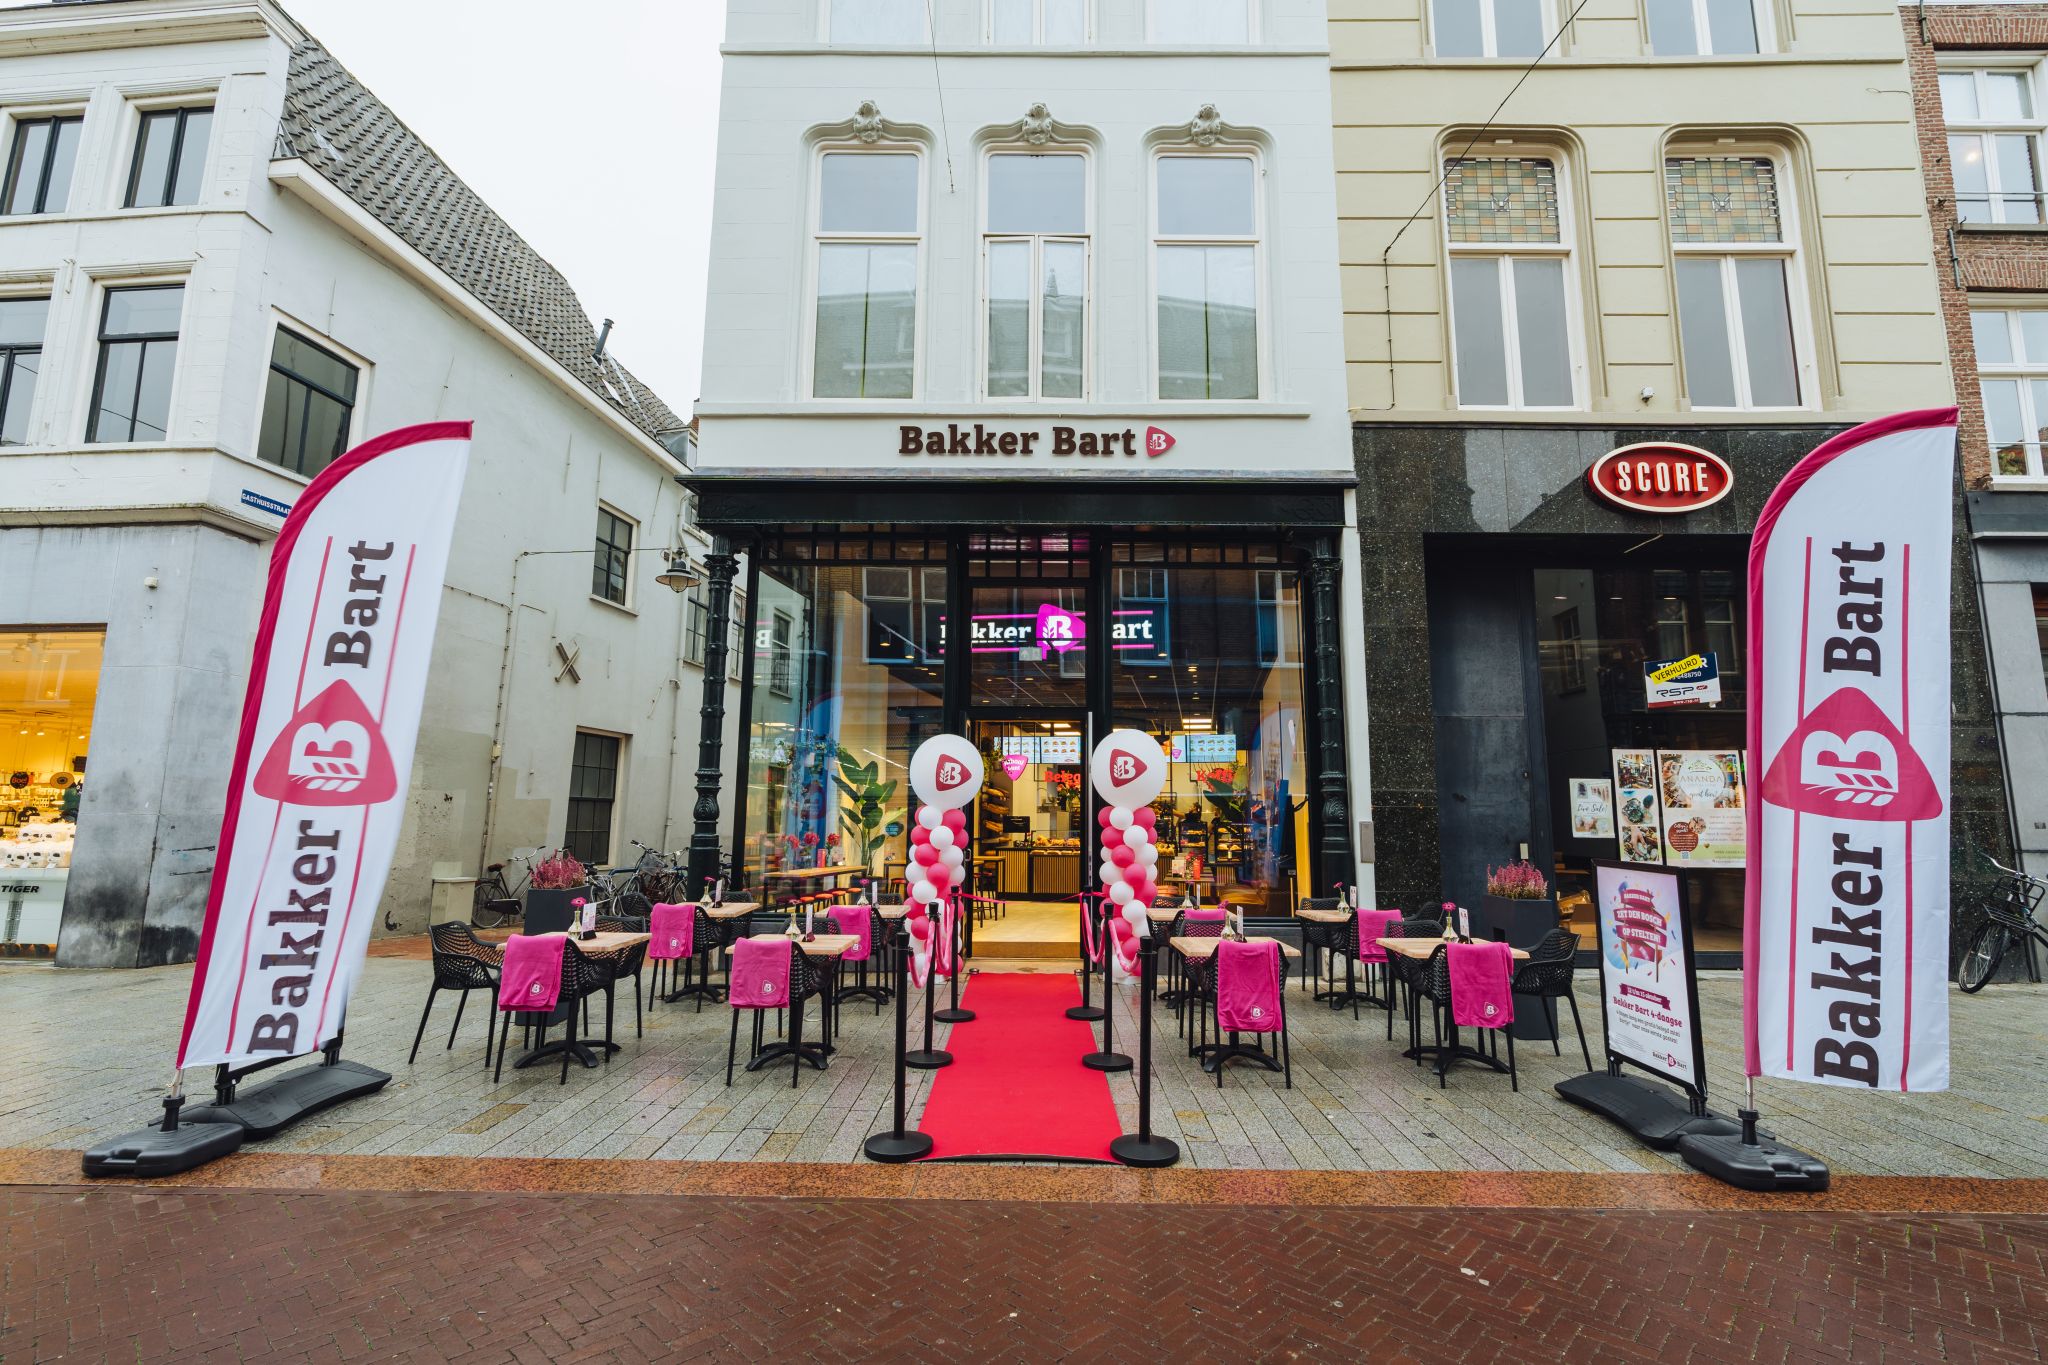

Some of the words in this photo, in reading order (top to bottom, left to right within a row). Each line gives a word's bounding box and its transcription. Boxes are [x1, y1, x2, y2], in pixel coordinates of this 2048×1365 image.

[899, 424, 1039, 455] Bakker
[1052, 426, 1137, 456] Bart
[1616, 461, 1709, 492] SCORE
[1823, 541, 1885, 677] Bart
[1112, 619, 1153, 639] art
[1655, 657, 1698, 681] VERHUURD
[1656, 686, 1694, 698] RSP
[1681, 775, 1723, 783] ANANDA
[246, 820, 341, 1054] Bakker
[324, 540, 394, 669] Bart
[1, 885, 40, 894] TIGER
[1628, 911, 1641, 919] DEN
[1641, 912, 1662, 926] BOSCH
[1622, 928, 1631, 936] OP
[1631, 928, 1661, 942] STELTEN!
[1811, 832, 1883, 1088] Bakker
[1613, 996, 1634, 1010] Bakker
[1635, 1003, 1650, 1017] Bart
[1651, 1010, 1683, 1028] 4-daagse
